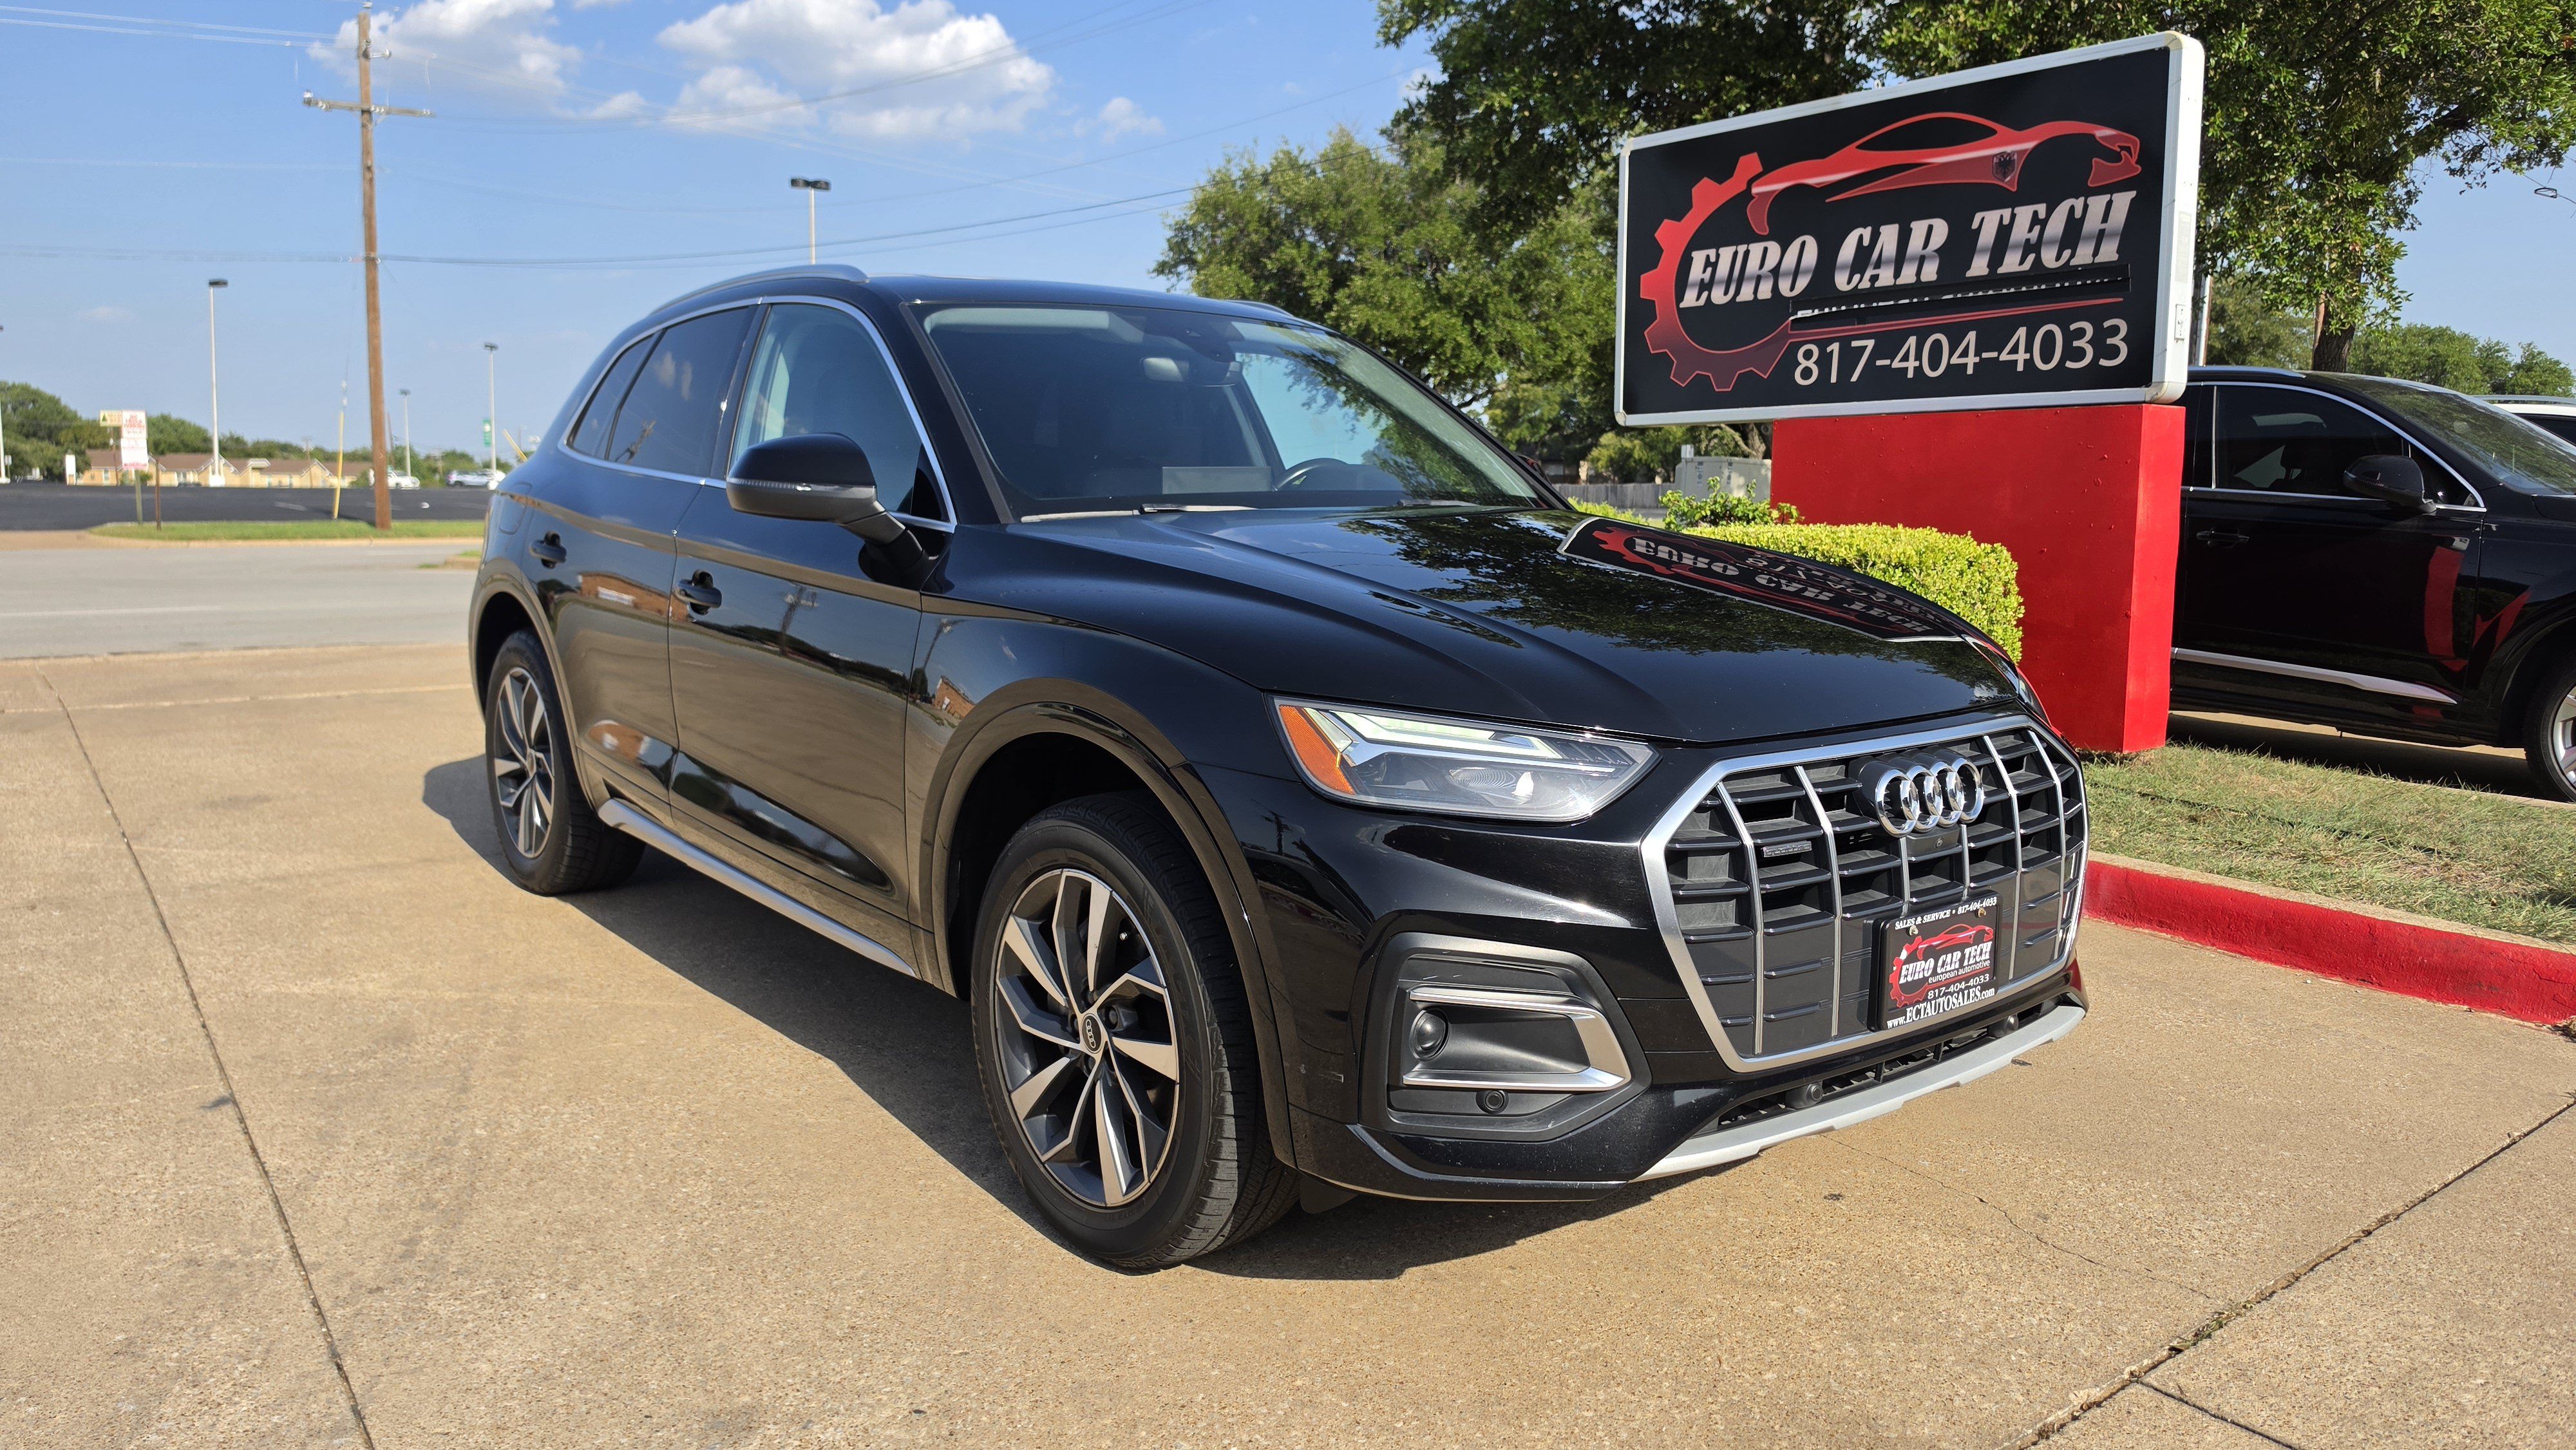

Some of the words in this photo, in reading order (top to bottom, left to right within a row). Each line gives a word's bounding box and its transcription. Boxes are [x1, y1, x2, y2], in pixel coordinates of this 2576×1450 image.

[1680, 235, 1819, 308] EURO
[1834, 217, 1949, 290] CAR
[1965, 191, 2136, 278] TECH
[1794, 318, 2128, 386] 817-404-4033
[1895, 918, 1916, 930] SALES
[1916, 916, 1922, 925] &
[1922, 909, 1951, 923] SERVICE
[1957, 896, 1997, 914] 817-404-4033
[1899, 958, 1935, 984] EURO
[1937, 950, 1962, 974] CAR
[1963, 941, 1993, 966] TECH
[1928, 969, 1957, 983] european
[1958, 959, 1991, 974] automotive
[1887, 986, 1995, 1029] www.ECTAUTOSALES.com
[1927, 974, 1989, 999] 817-404-4033
